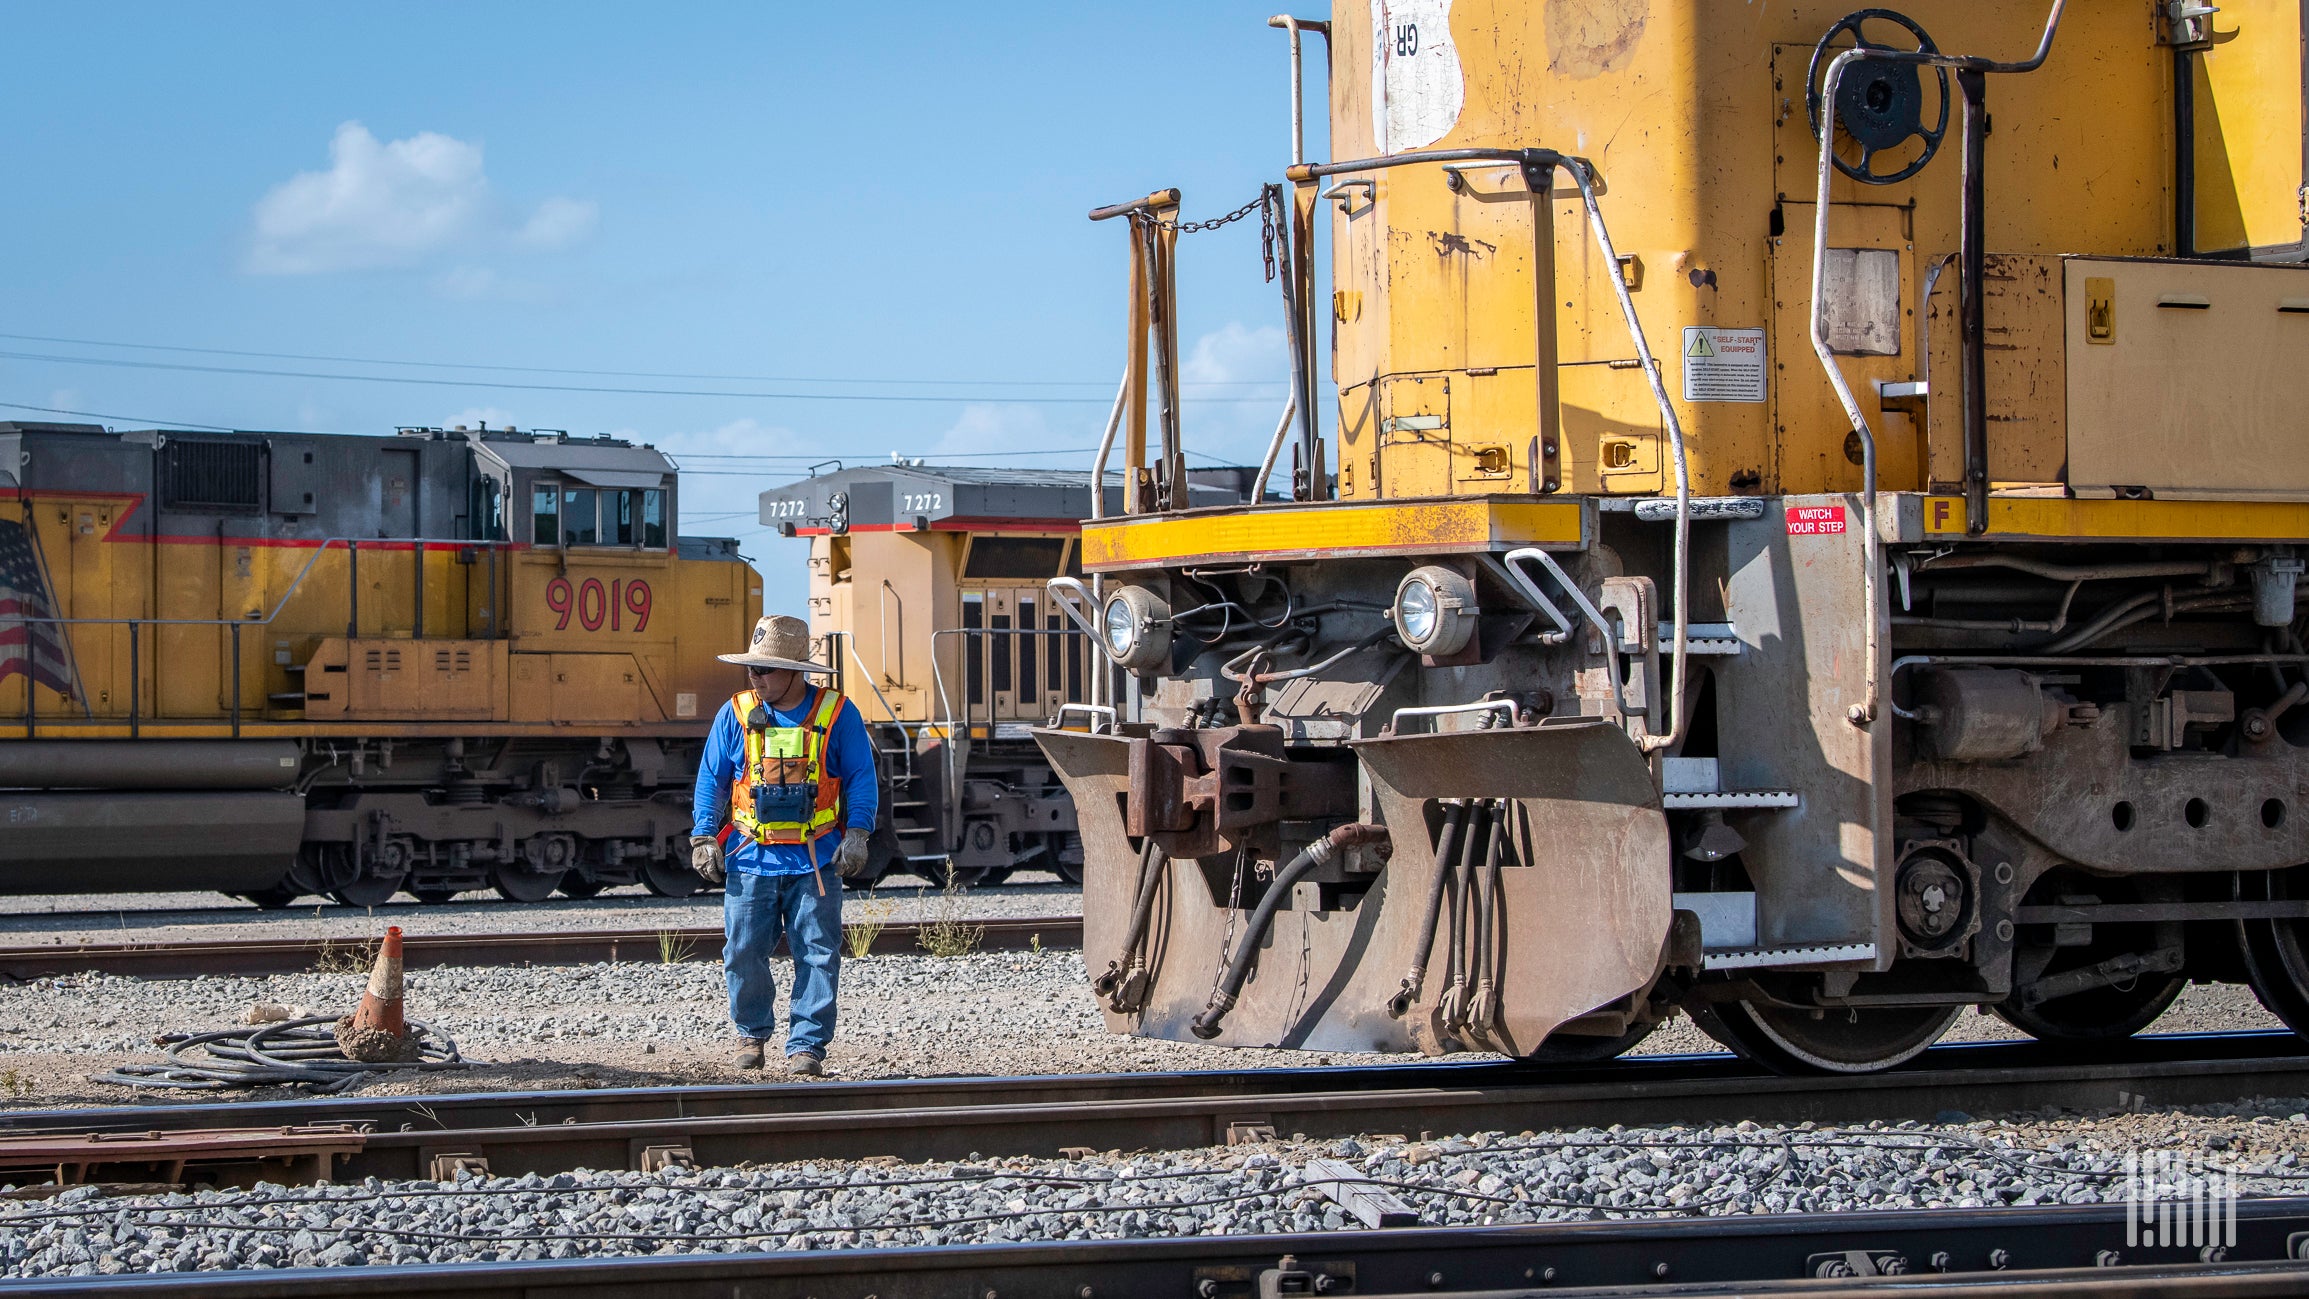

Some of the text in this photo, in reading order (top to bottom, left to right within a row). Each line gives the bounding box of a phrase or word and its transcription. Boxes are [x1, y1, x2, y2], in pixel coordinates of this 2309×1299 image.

[1720, 345, 1755, 353] EQUIPPED
[769, 500, 805, 518] 7272
[904, 493, 942, 511] 7272
[1798, 508, 1832, 520] WATCH
[1934, 501, 1949, 529] F
[1788, 521, 1844, 533] YOUR STEP
[546, 577, 652, 632] 9019
